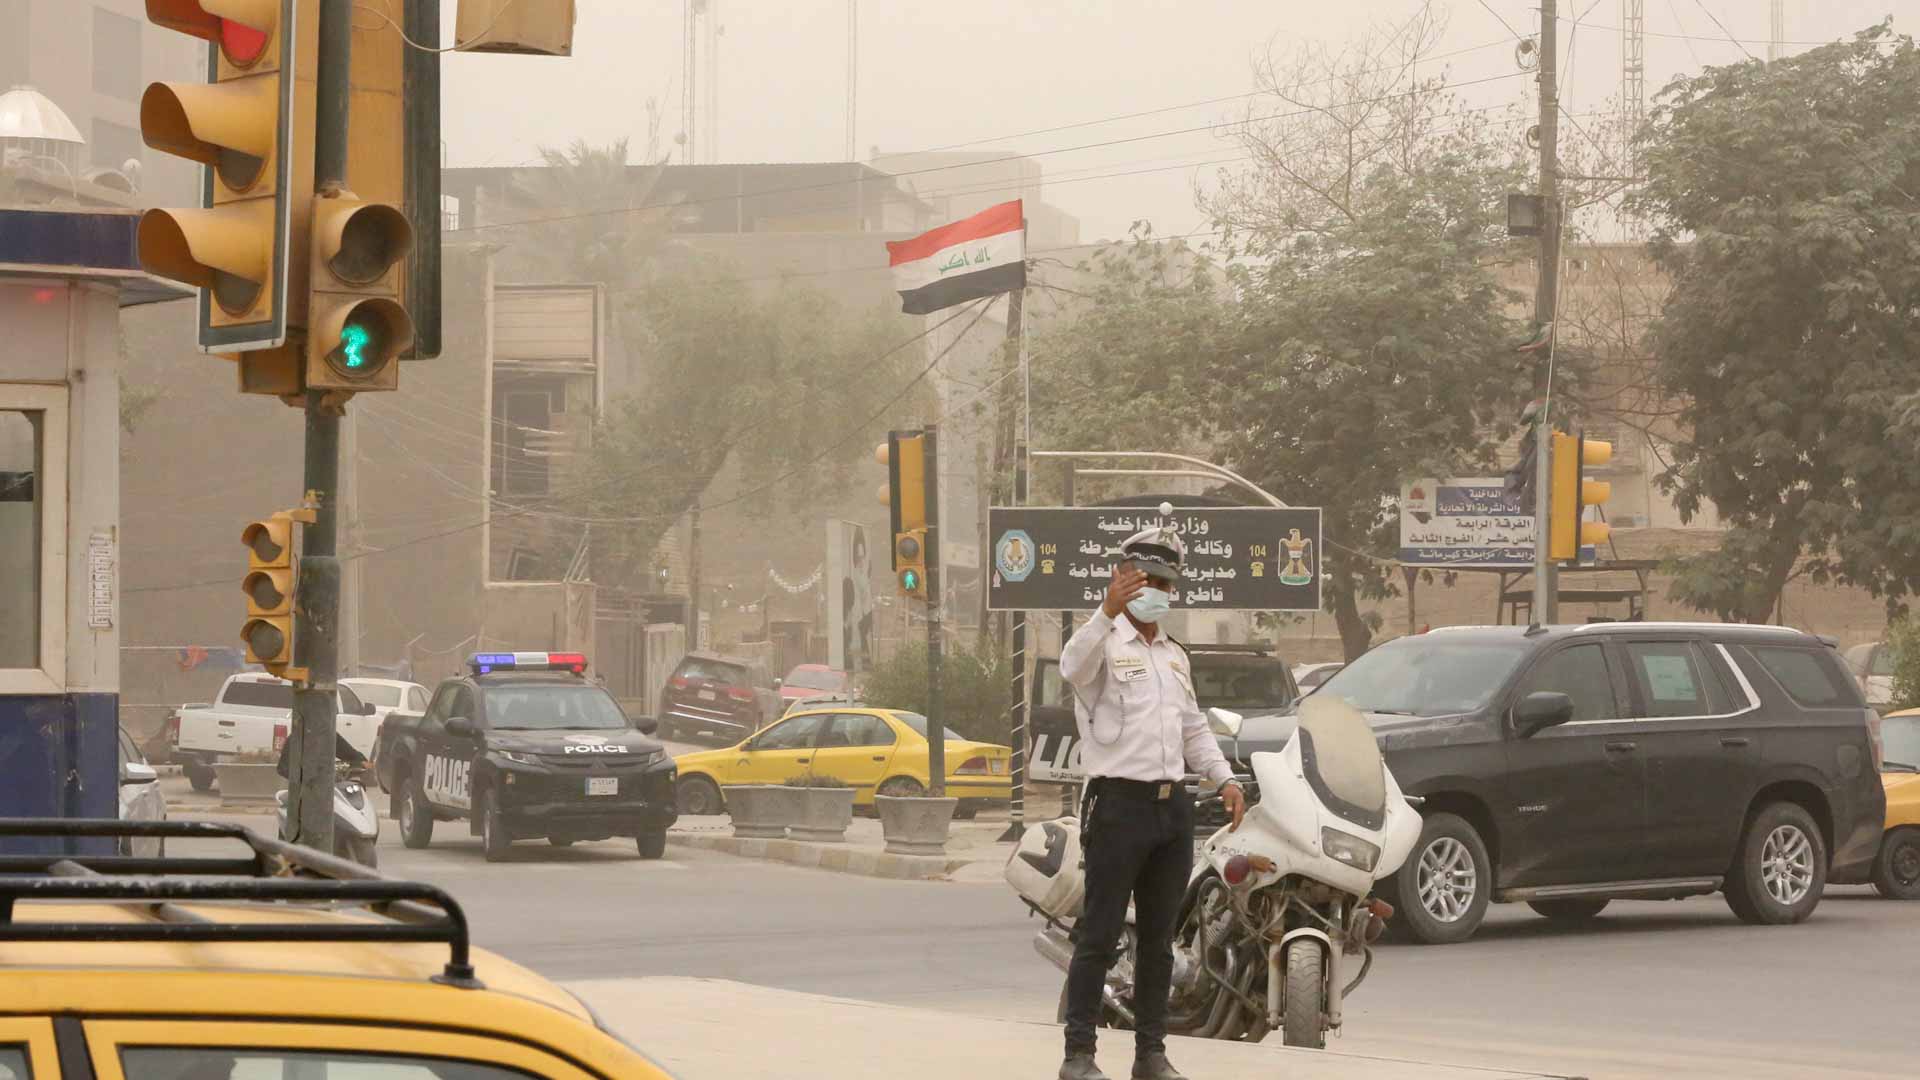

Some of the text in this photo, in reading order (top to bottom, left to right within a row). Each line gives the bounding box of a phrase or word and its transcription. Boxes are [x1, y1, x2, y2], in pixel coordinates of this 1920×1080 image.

[974, 246, 991, 264] الله
[1469, 488, 1502, 500] الداخلية
[1477, 503, 1506, 514] الشرطة
[1507, 503, 1521, 515] وات
[1098, 516, 1209, 534] وزارة الداخلية
[1456, 518, 1530, 530] الفرقة الرابعة
[1409, 532, 1442, 543] الثالث
[1445, 534, 1474, 545] الفوج
[1485, 532, 1509, 545] عشر
[1039, 543, 1057, 555] 104
[1193, 540, 1233, 558] وكالة
[1248, 544, 1266, 557] 104
[1068, 562, 1237, 581] مديرية لعامة
[1185, 586, 1224, 604] قاطع
[564, 744, 628, 754] POLICE
[424, 754, 471, 802] POLICE
